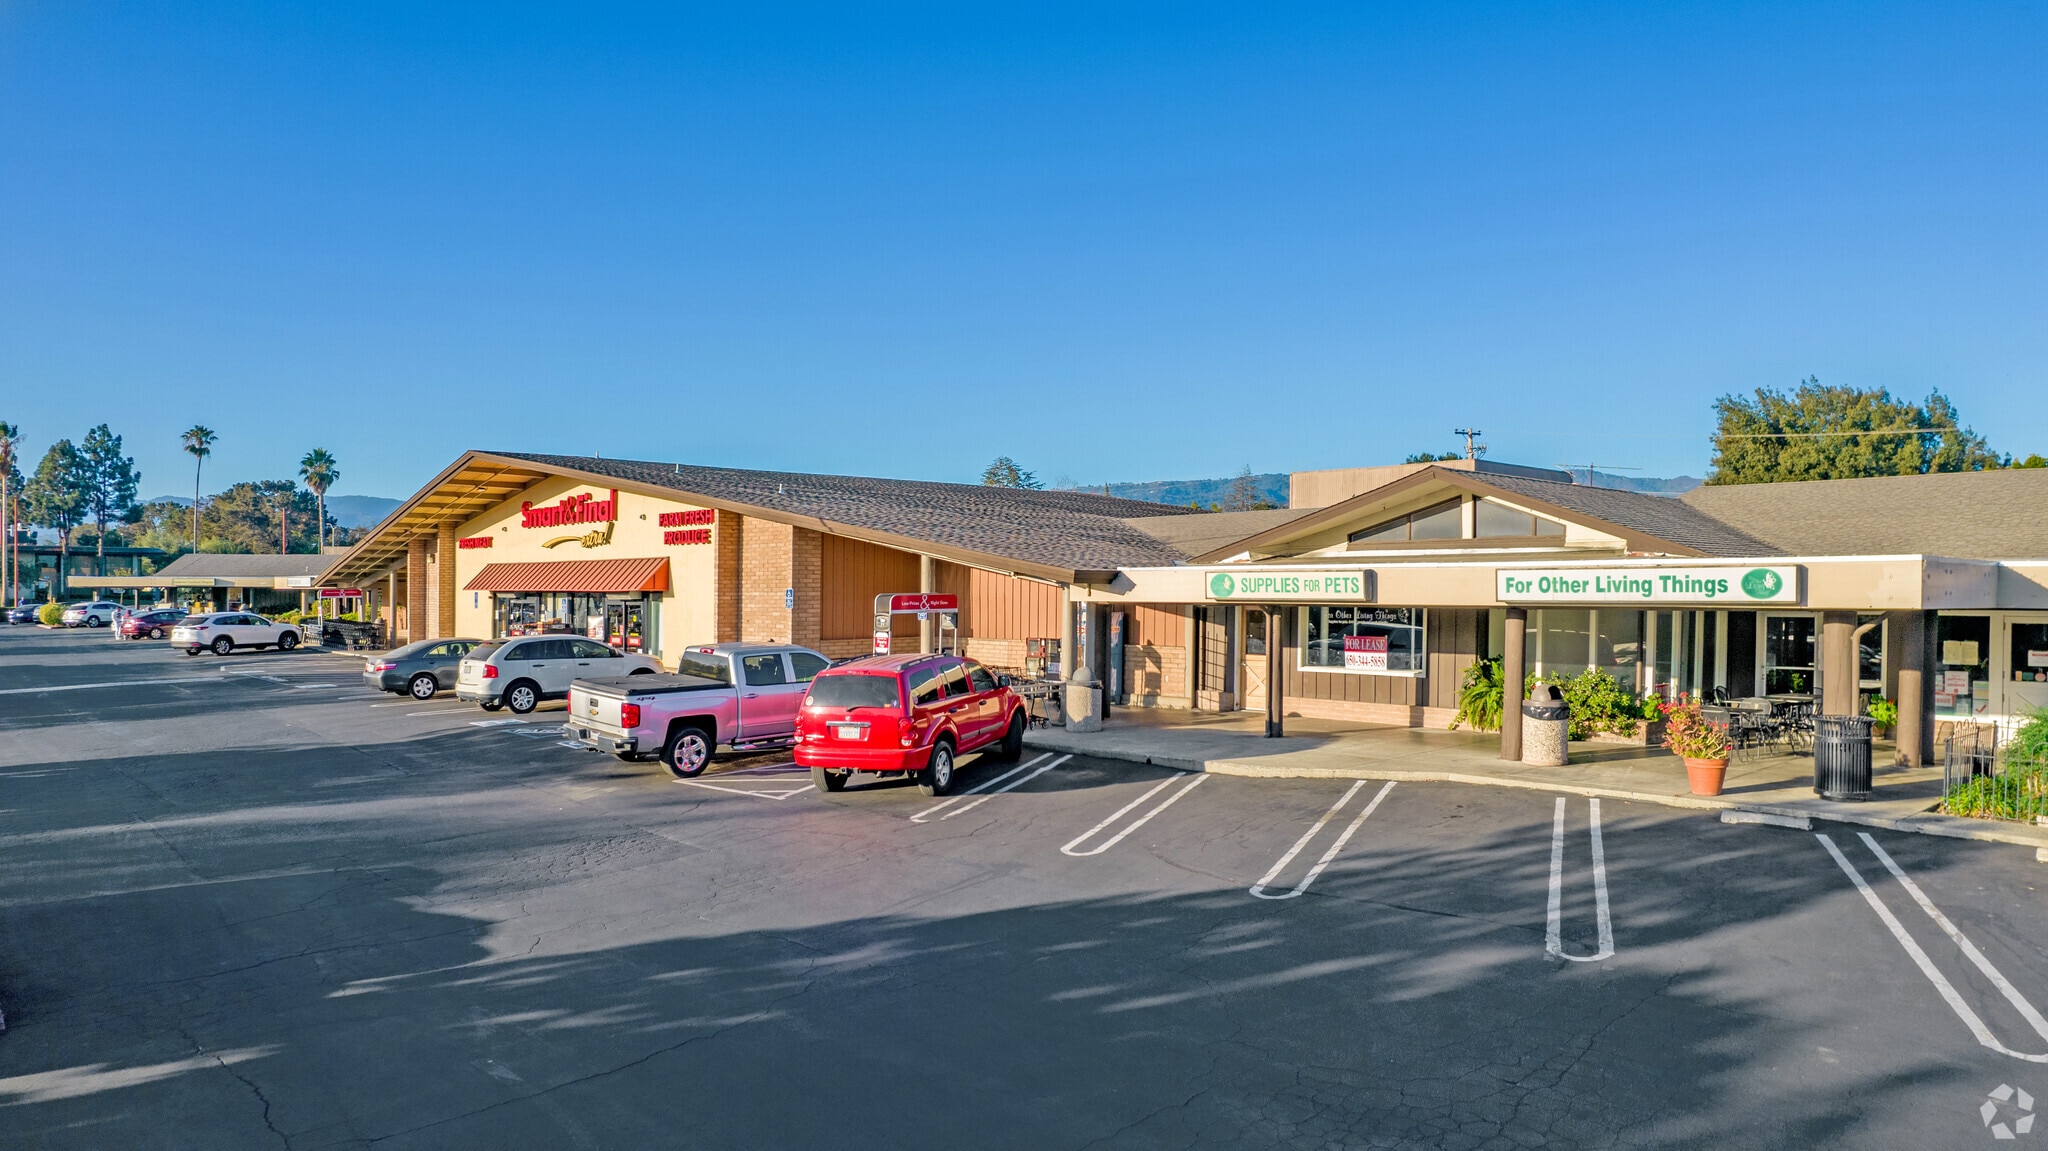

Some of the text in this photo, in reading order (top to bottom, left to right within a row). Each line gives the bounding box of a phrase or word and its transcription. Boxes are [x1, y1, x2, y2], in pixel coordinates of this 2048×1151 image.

[659, 508, 715, 528] FARM FRESH
[664, 529, 712, 546] PRODUCE
[1241, 577, 1360, 593] SUPPLIES FOR PETS
[1505, 577, 1533, 593] For
[1538, 576, 1589, 594] Other
[1595, 575, 1651, 597] Living
[1659, 574, 1729, 597] Things
[1374, 609, 1397, 622] Things
[1345, 638, 1385, 651] FOR LEASE
[1346, 655, 1386, 668] 650-344-5858
